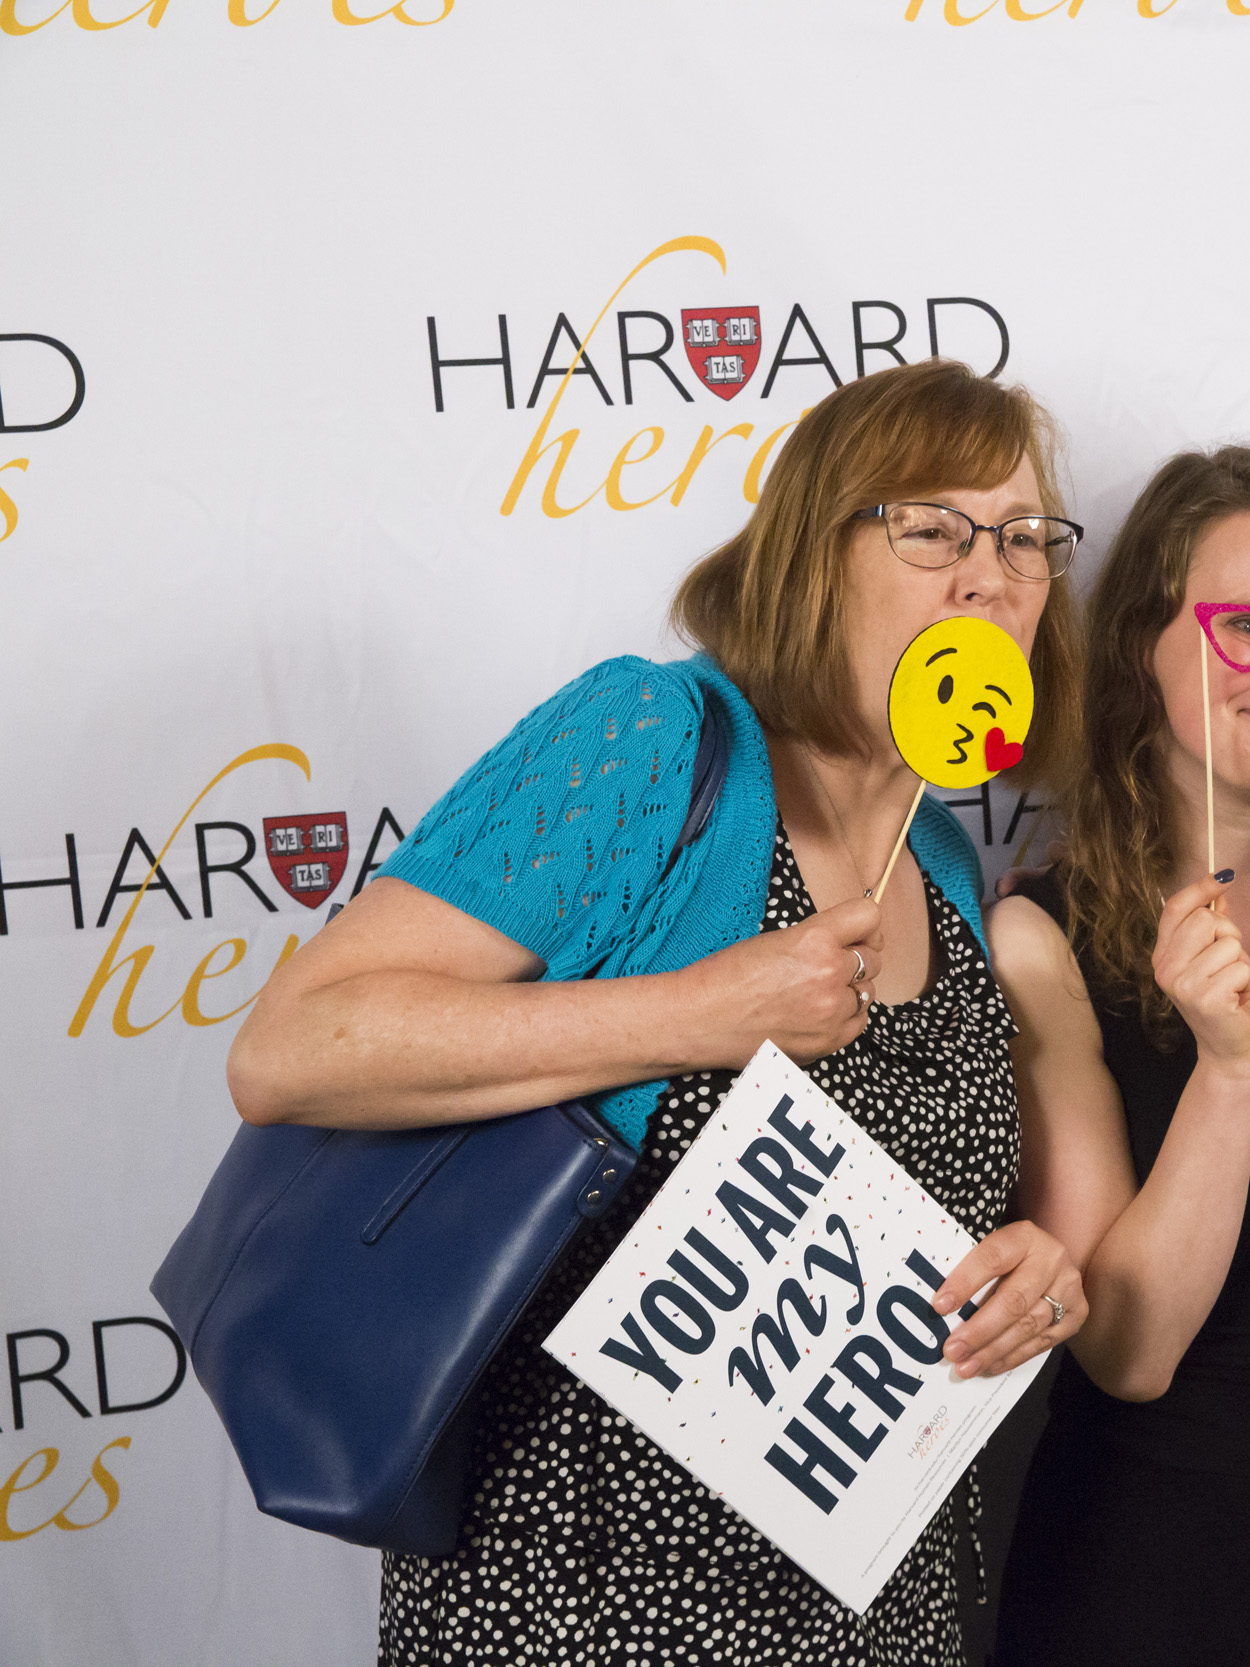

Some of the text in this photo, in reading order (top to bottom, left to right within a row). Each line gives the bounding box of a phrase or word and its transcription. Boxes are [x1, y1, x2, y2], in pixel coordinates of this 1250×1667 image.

[713, 361, 736, 374] TAS
[298, 868, 322, 883] TAS
[599, 1093, 847, 1394] YOU ARE
[728, 1213, 866, 1406] my
